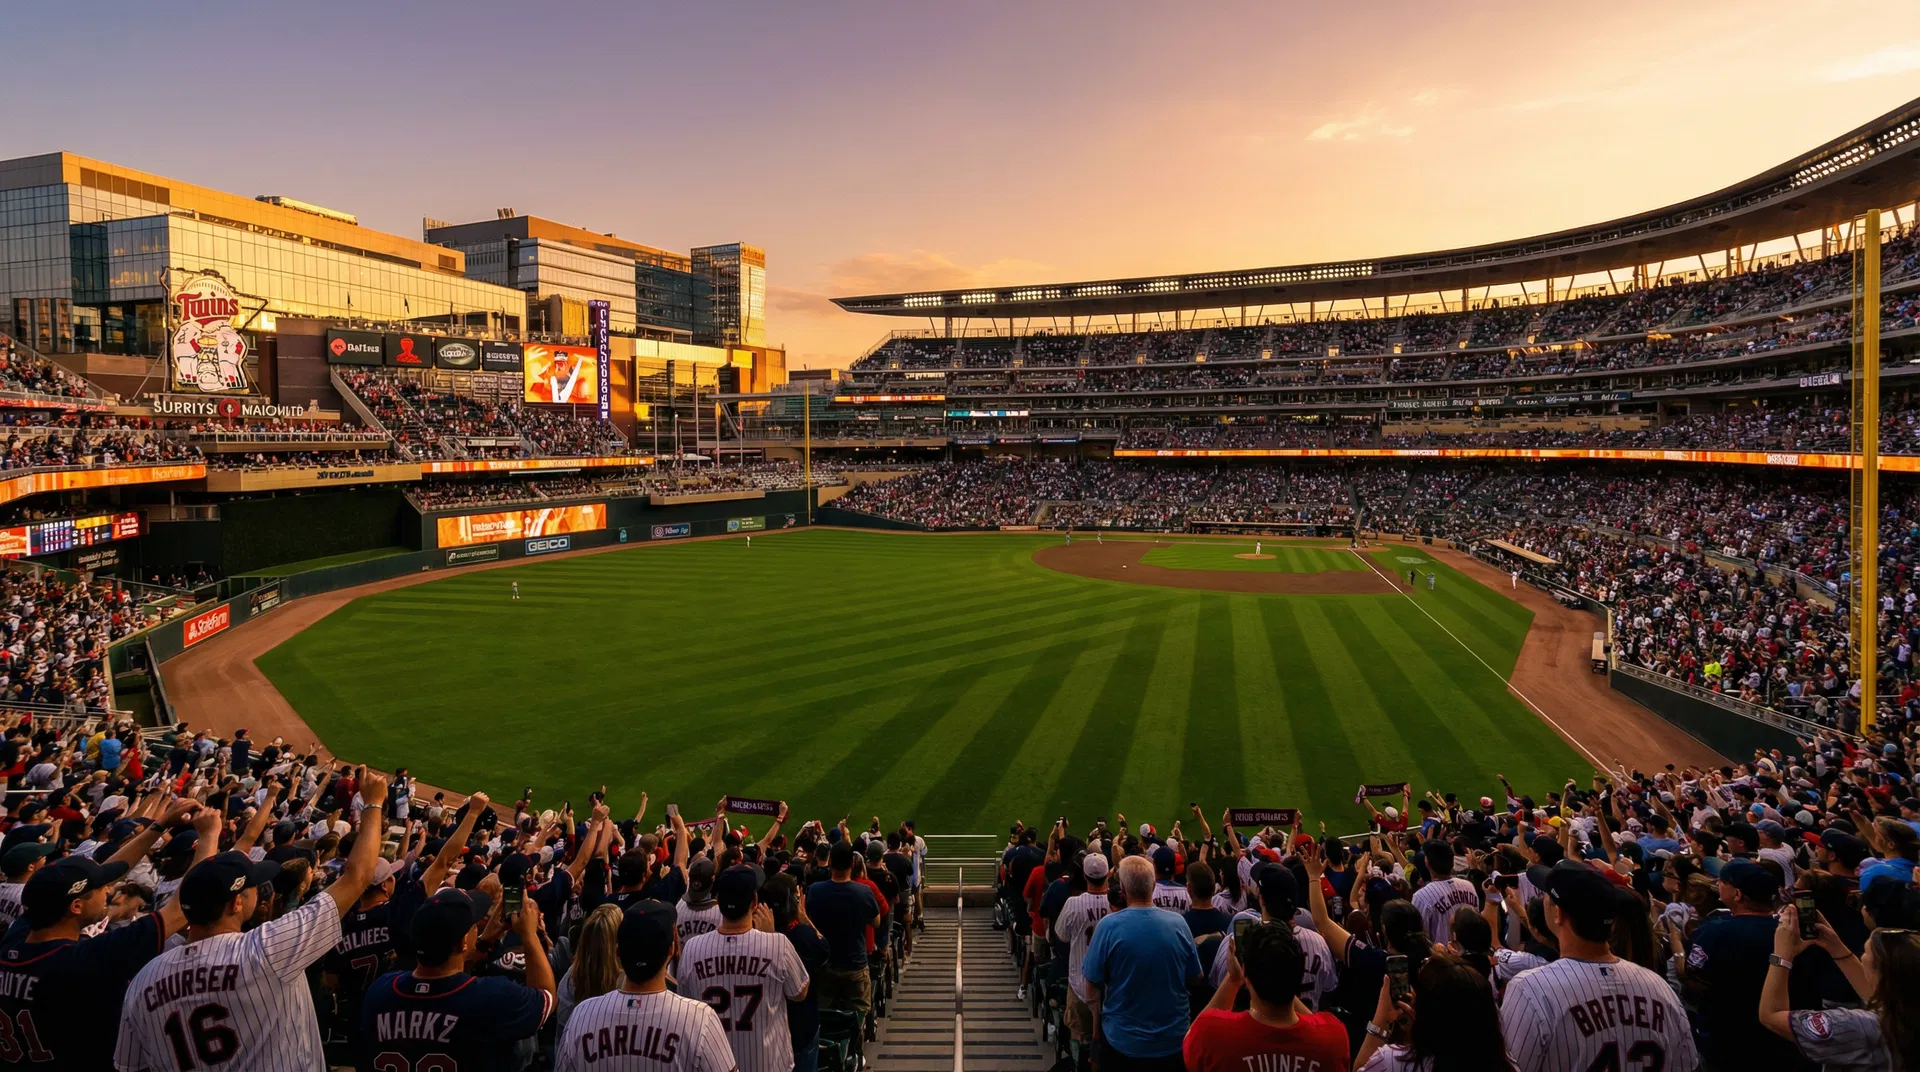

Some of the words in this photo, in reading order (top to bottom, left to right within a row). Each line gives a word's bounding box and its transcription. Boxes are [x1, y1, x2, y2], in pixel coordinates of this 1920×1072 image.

[177, 291, 239, 321] Twins
[528, 539, 567, 552] GEICO
[701, 983, 763, 1033] 27
[164, 1002, 240, 1071] 16
